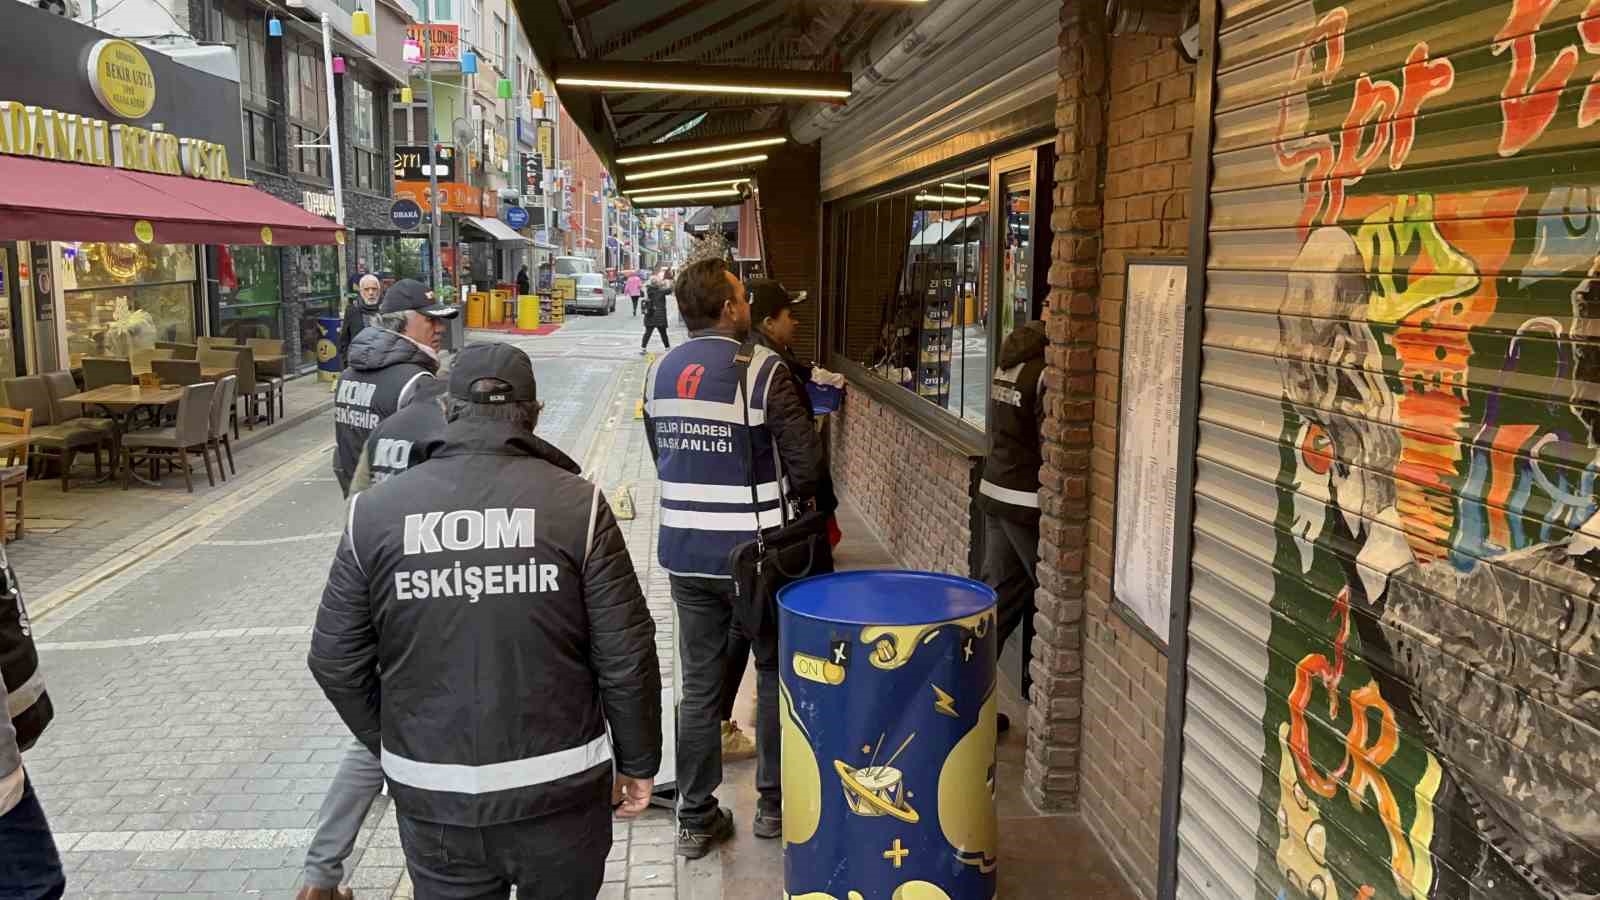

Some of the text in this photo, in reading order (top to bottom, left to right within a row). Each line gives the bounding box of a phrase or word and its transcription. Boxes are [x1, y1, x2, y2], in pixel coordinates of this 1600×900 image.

[180, 138, 230, 180] USTA
[336, 380, 377, 407] KOM
[680, 420, 732, 438] İDARESİ
[373, 438, 414, 469] KO
[403, 508, 536, 555] KOM
[394, 557, 560, 604] ESKİŞEHİR
[799, 660, 818, 676] ON
